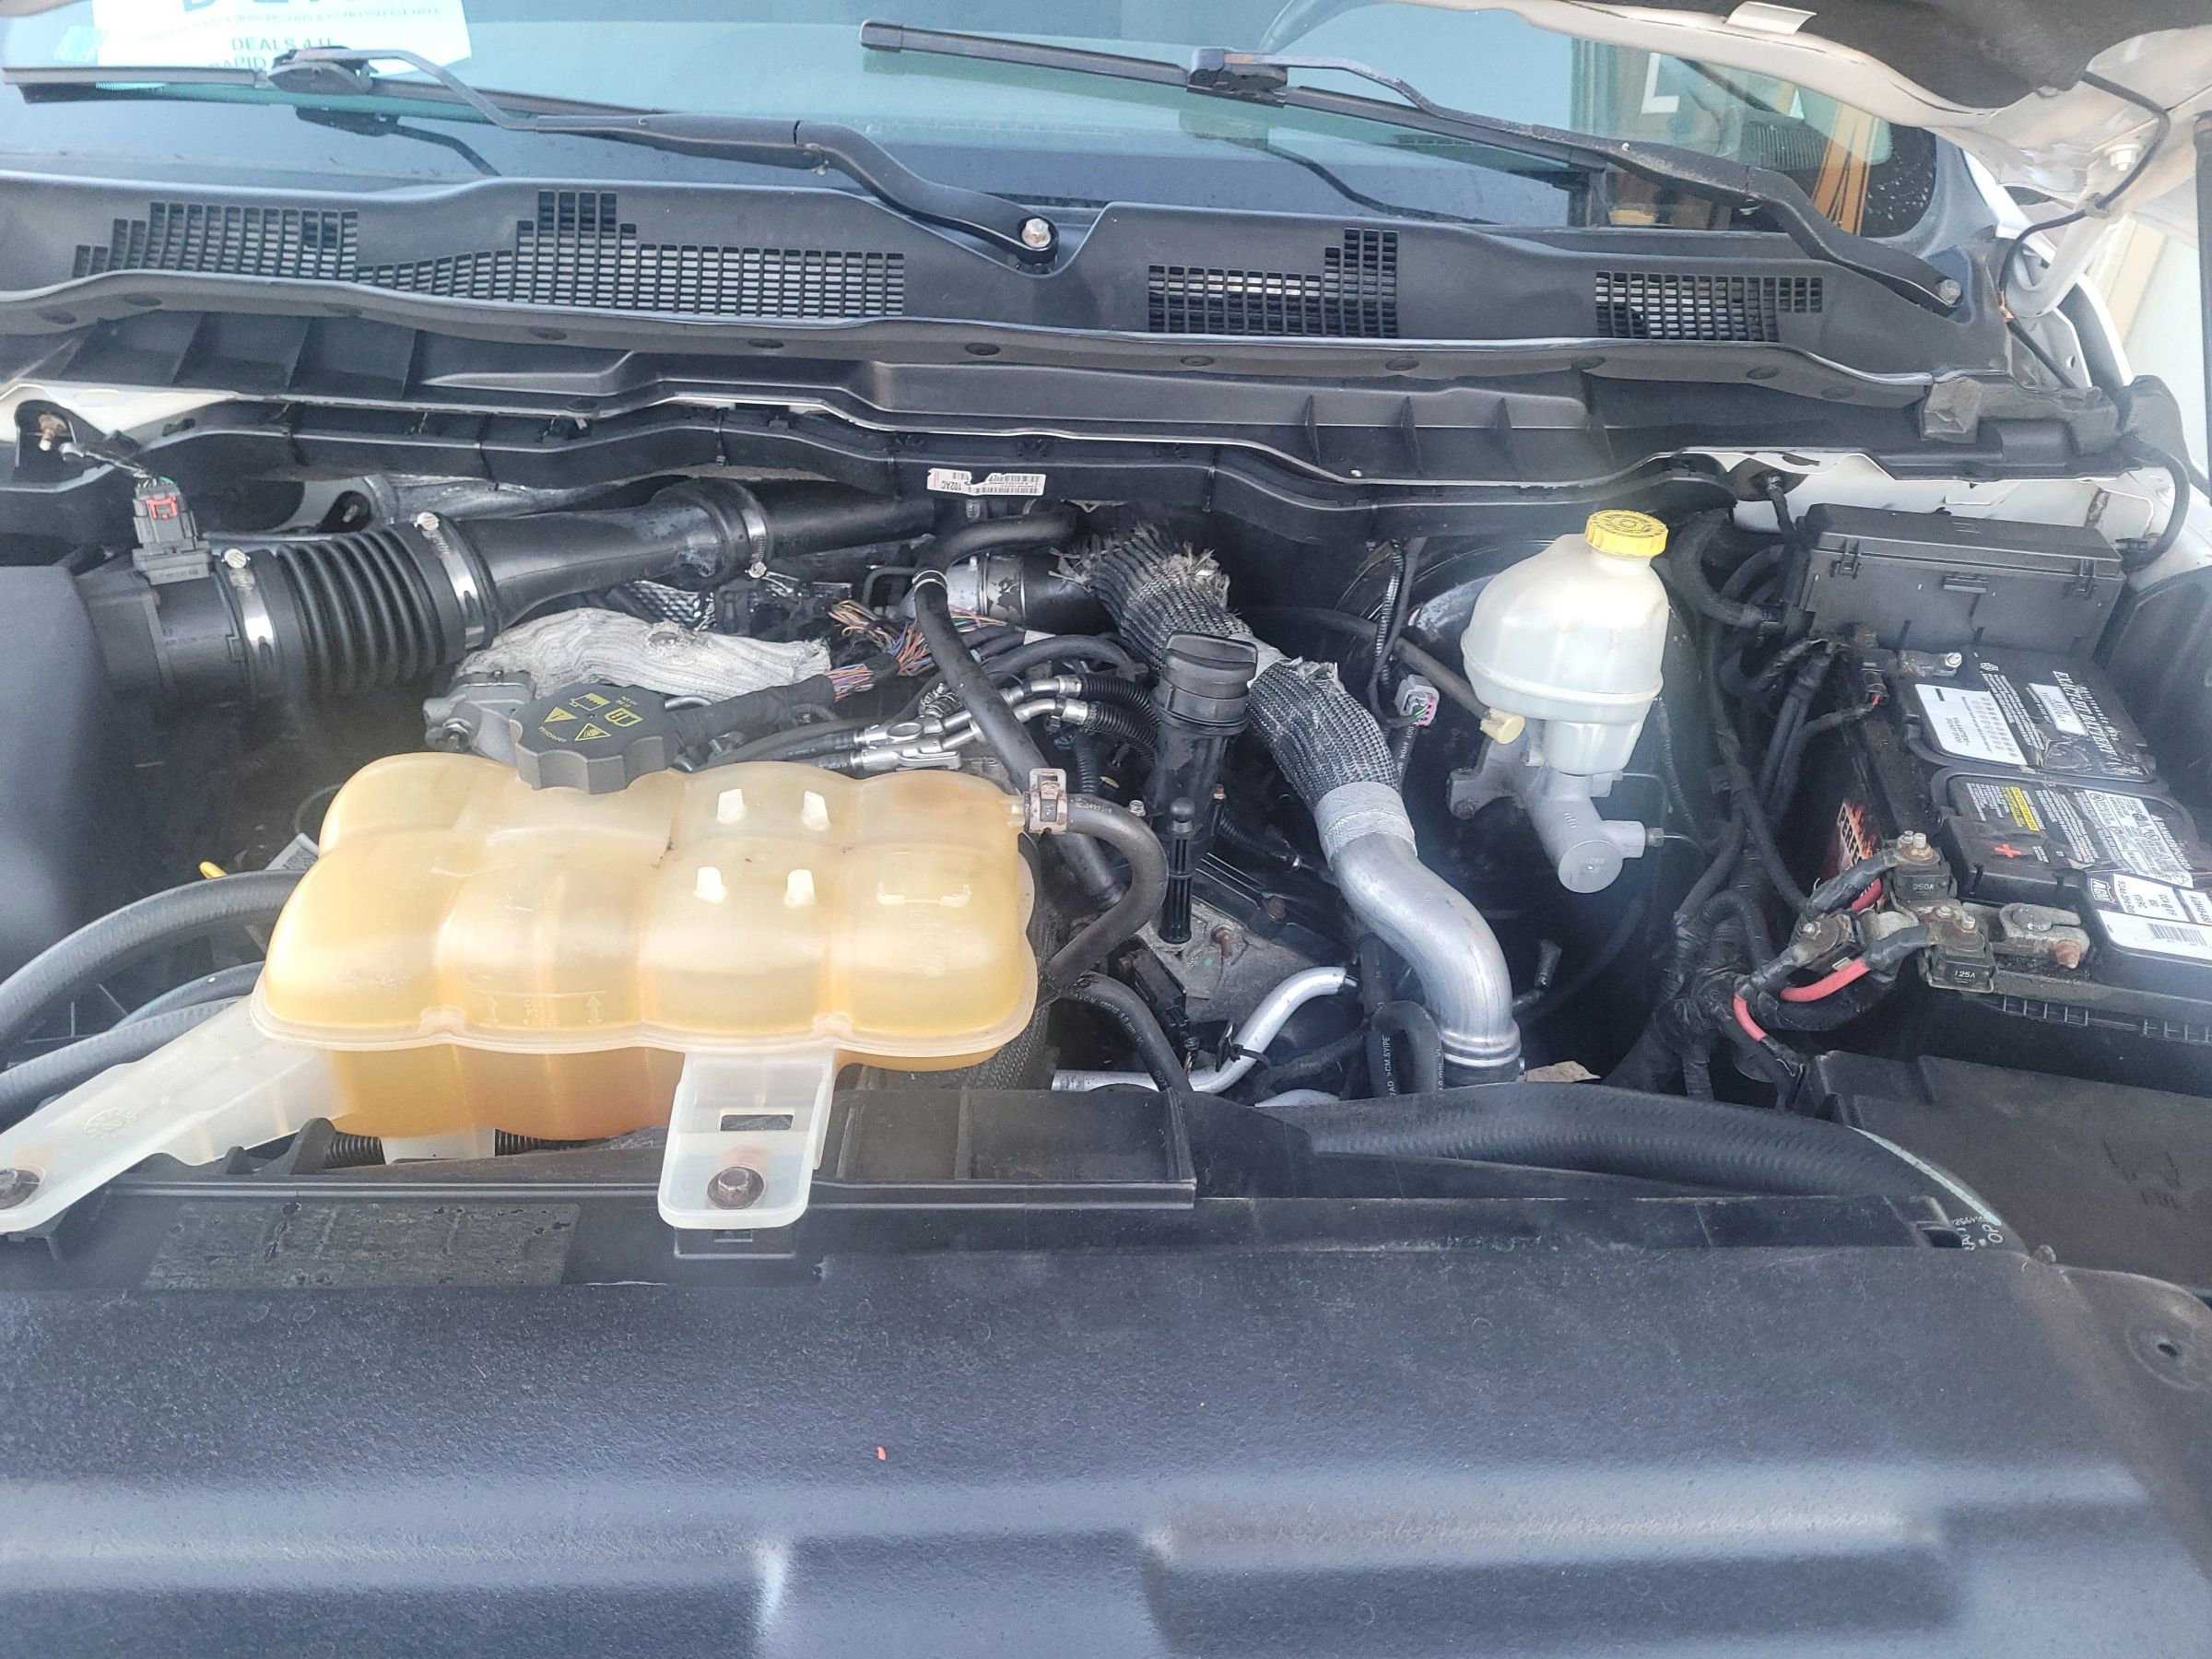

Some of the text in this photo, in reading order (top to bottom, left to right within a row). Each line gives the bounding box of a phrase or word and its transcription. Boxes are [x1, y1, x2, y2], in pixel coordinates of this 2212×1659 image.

[231, 37, 298, 52] DEALS
[2053, 670, 2095, 714] EXACT-FIT
[2077, 712, 2119, 756] BATTERY
[1406, 726, 1415, 738] DOT
[1399, 741, 1409, 759] AVON
[1839, 806, 1864, 865] PERFE
[1954, 970, 1976, 979] 125A
[1154, 1070, 1169, 1087] DOT
